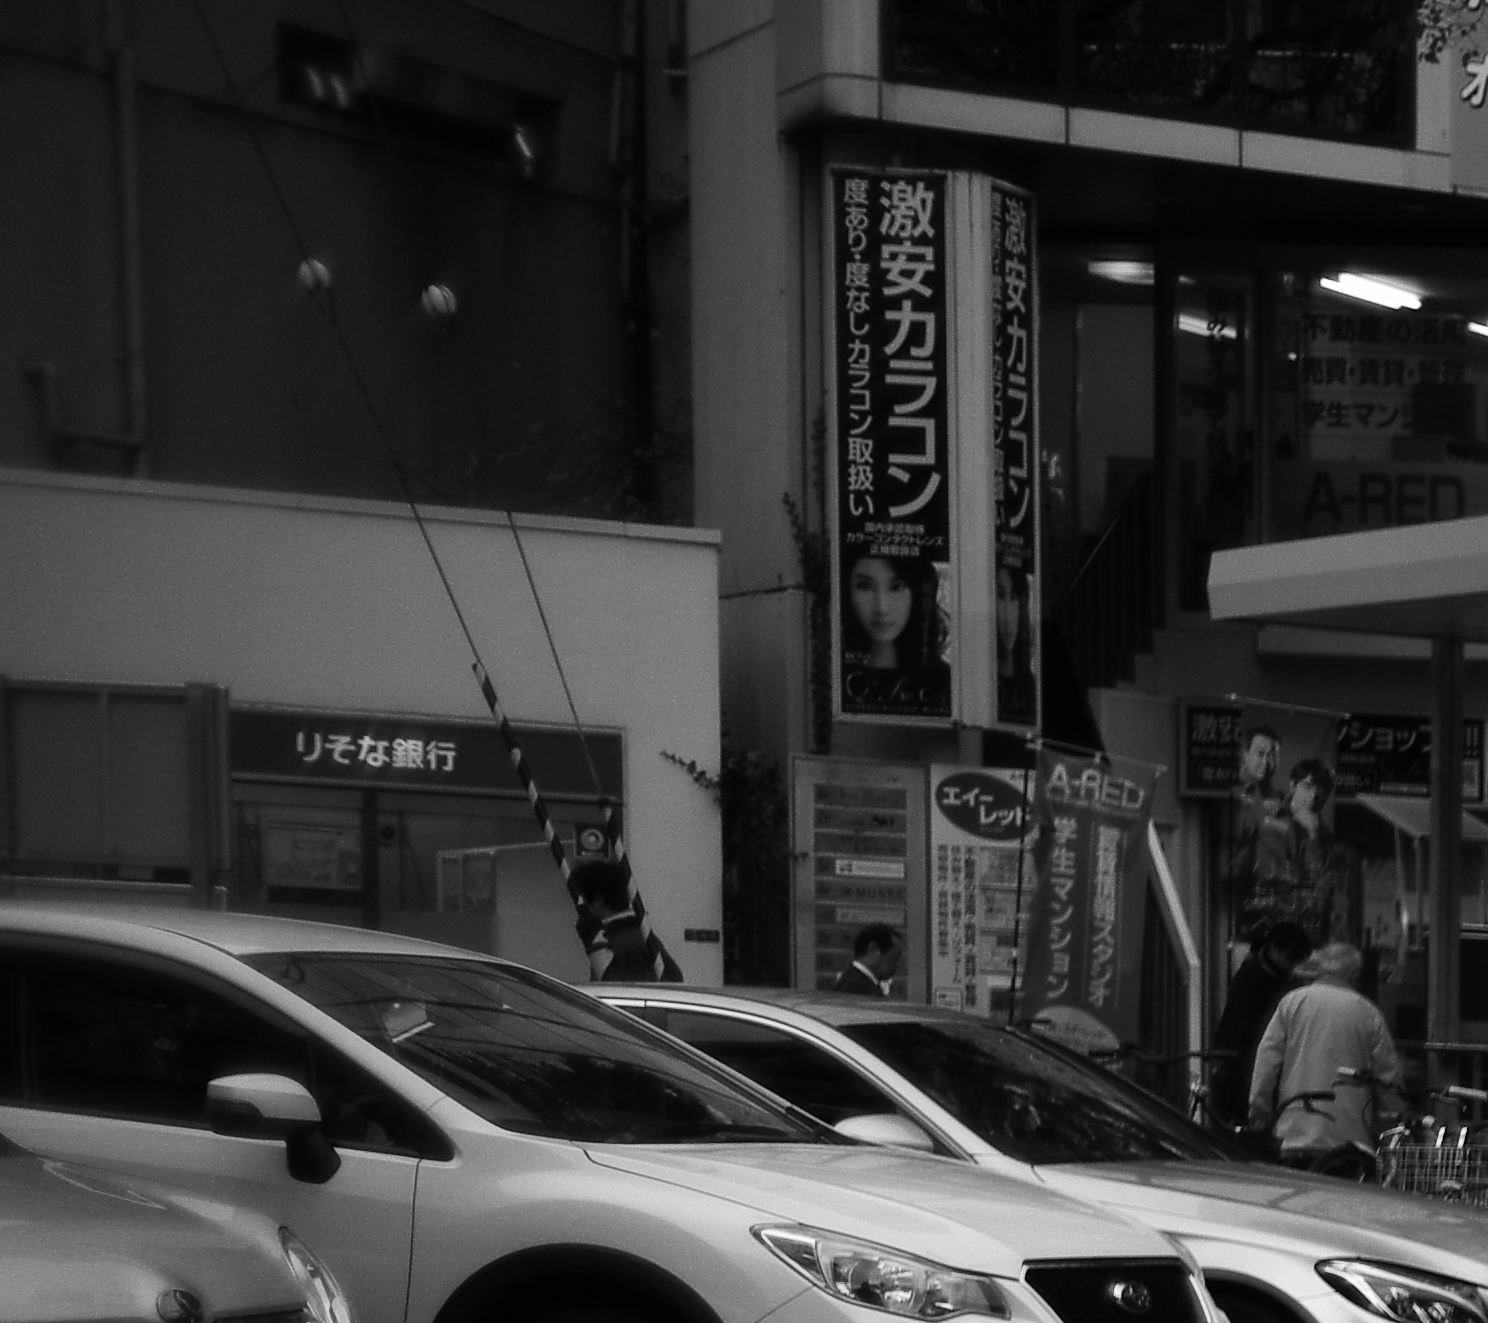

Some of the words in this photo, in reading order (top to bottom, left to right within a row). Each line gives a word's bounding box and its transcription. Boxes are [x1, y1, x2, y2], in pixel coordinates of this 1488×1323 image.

[879, 181, 941, 519] 激安カラコン
[1302, 313, 1467, 345] 不動産の活用
[1004, 197, 1031, 530] 激安カラコン
[1303, 470, 1466, 526] A-RED
[293, 729, 458, 775] りそな銀行
[1046, 763, 1144, 808] A-RED
[1046, 816, 1078, 999] 学生マンション
